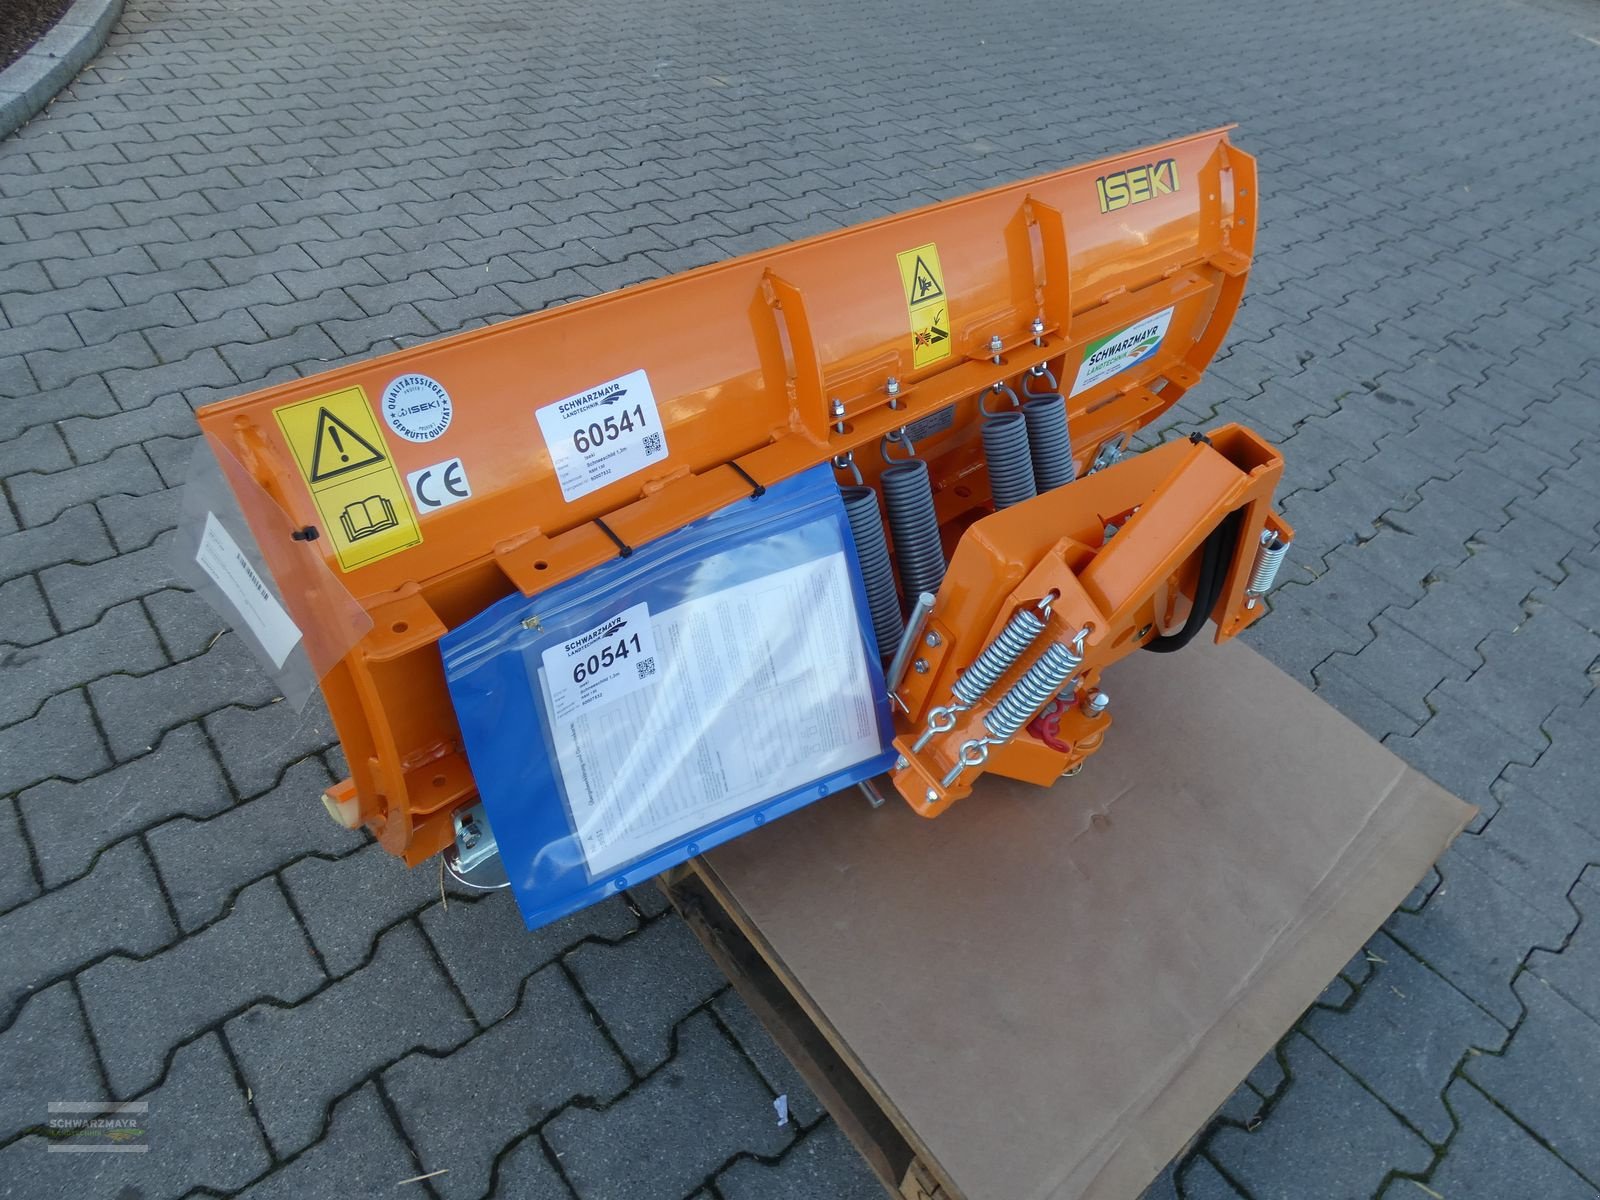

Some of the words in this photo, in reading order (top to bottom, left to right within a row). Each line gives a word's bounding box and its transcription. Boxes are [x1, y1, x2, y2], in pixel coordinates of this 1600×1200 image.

[1096, 158, 1180, 214] ISEKI
[1089, 325, 1158, 366] SCHWARZMAYR
[1087, 352, 1127, 376] LANDTECHNIK
[388, 377, 445, 409] QUALITÄTSSIEGEL
[408, 400, 441, 415] ISEKI
[558, 383, 620, 413] SCHWARZMAYR
[563, 402, 599, 419] LANDTECHNIK
[573, 404, 646, 453] 60541
[587, 451, 616, 467] Schneeschild
[416, 461, 468, 507] CE
[564, 617, 622, 652] SCHWARZMAYR
[567, 637, 601, 657] LANDTECHNIK
[573, 633, 641, 683] 60541
